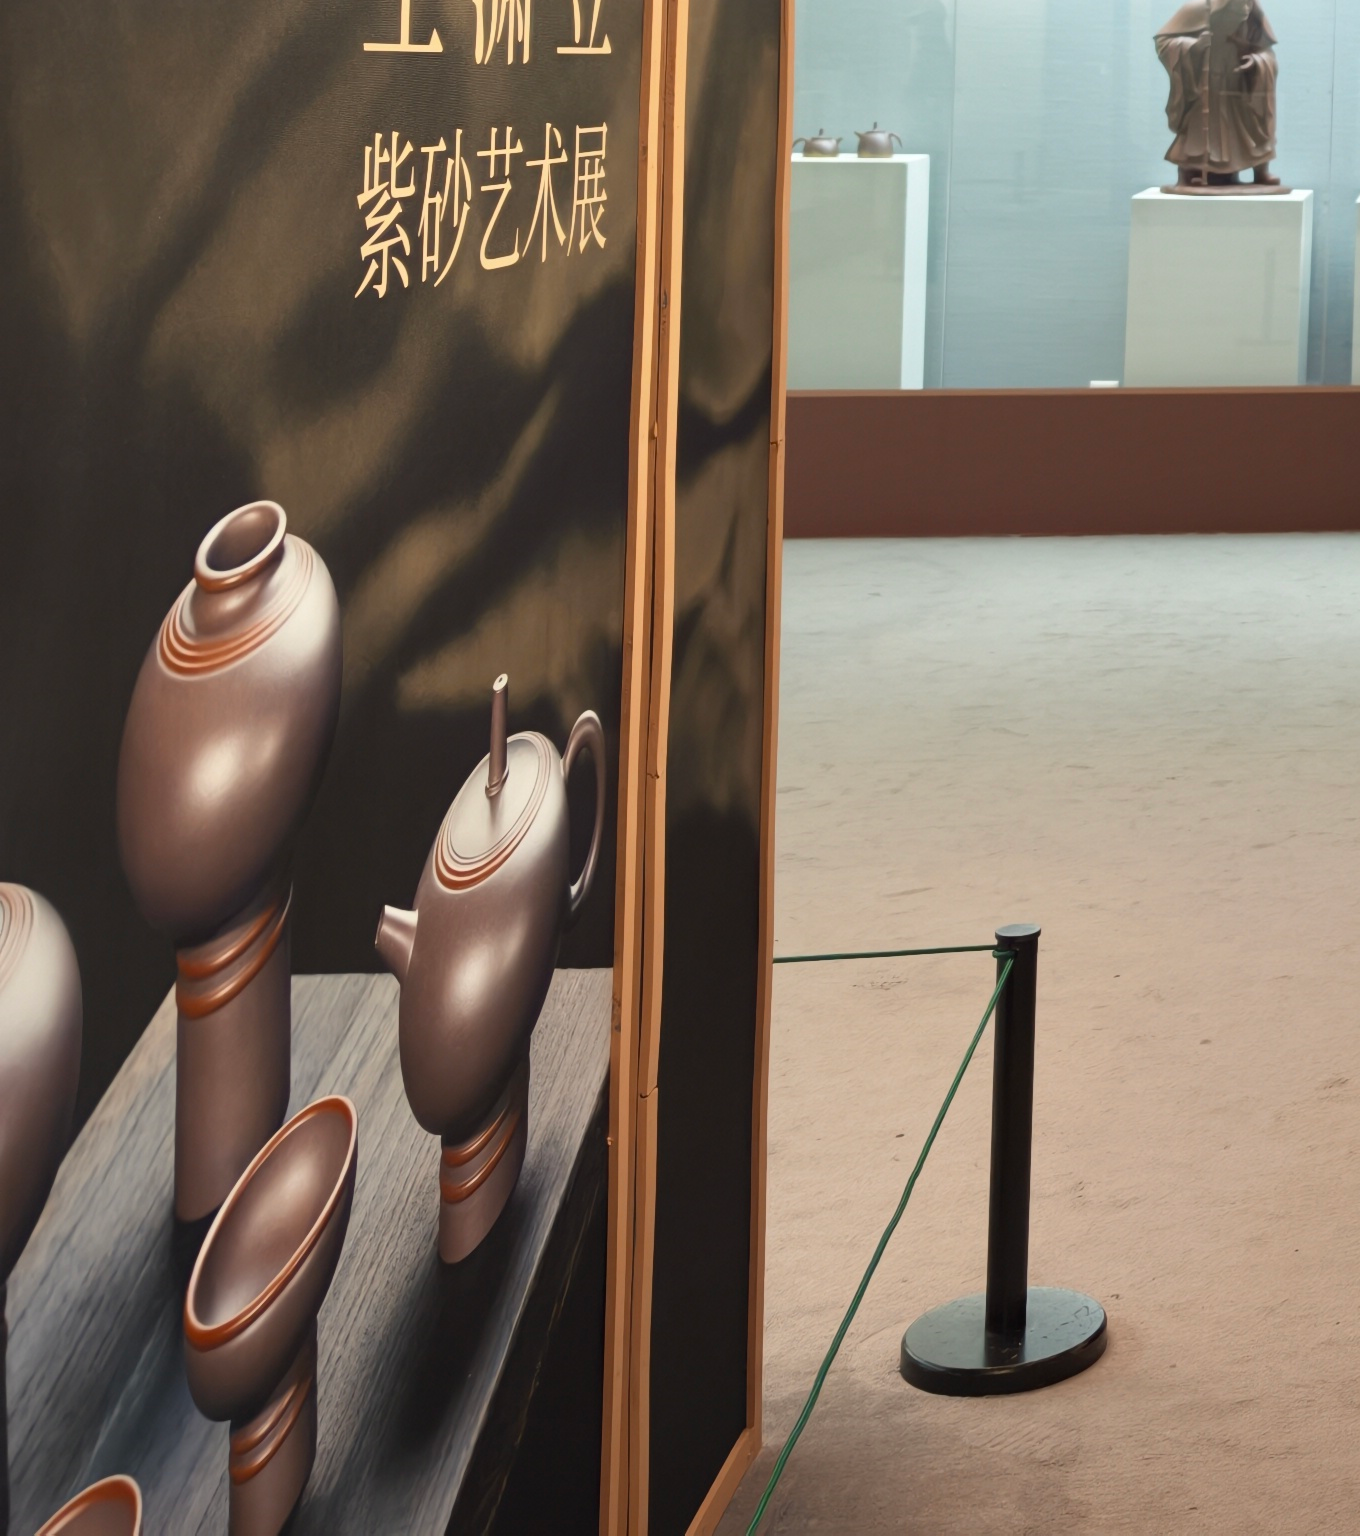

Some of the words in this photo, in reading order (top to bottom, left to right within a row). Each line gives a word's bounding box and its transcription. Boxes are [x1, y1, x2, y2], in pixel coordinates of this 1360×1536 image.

[354, 121, 610, 300] 紫砂艺术展
